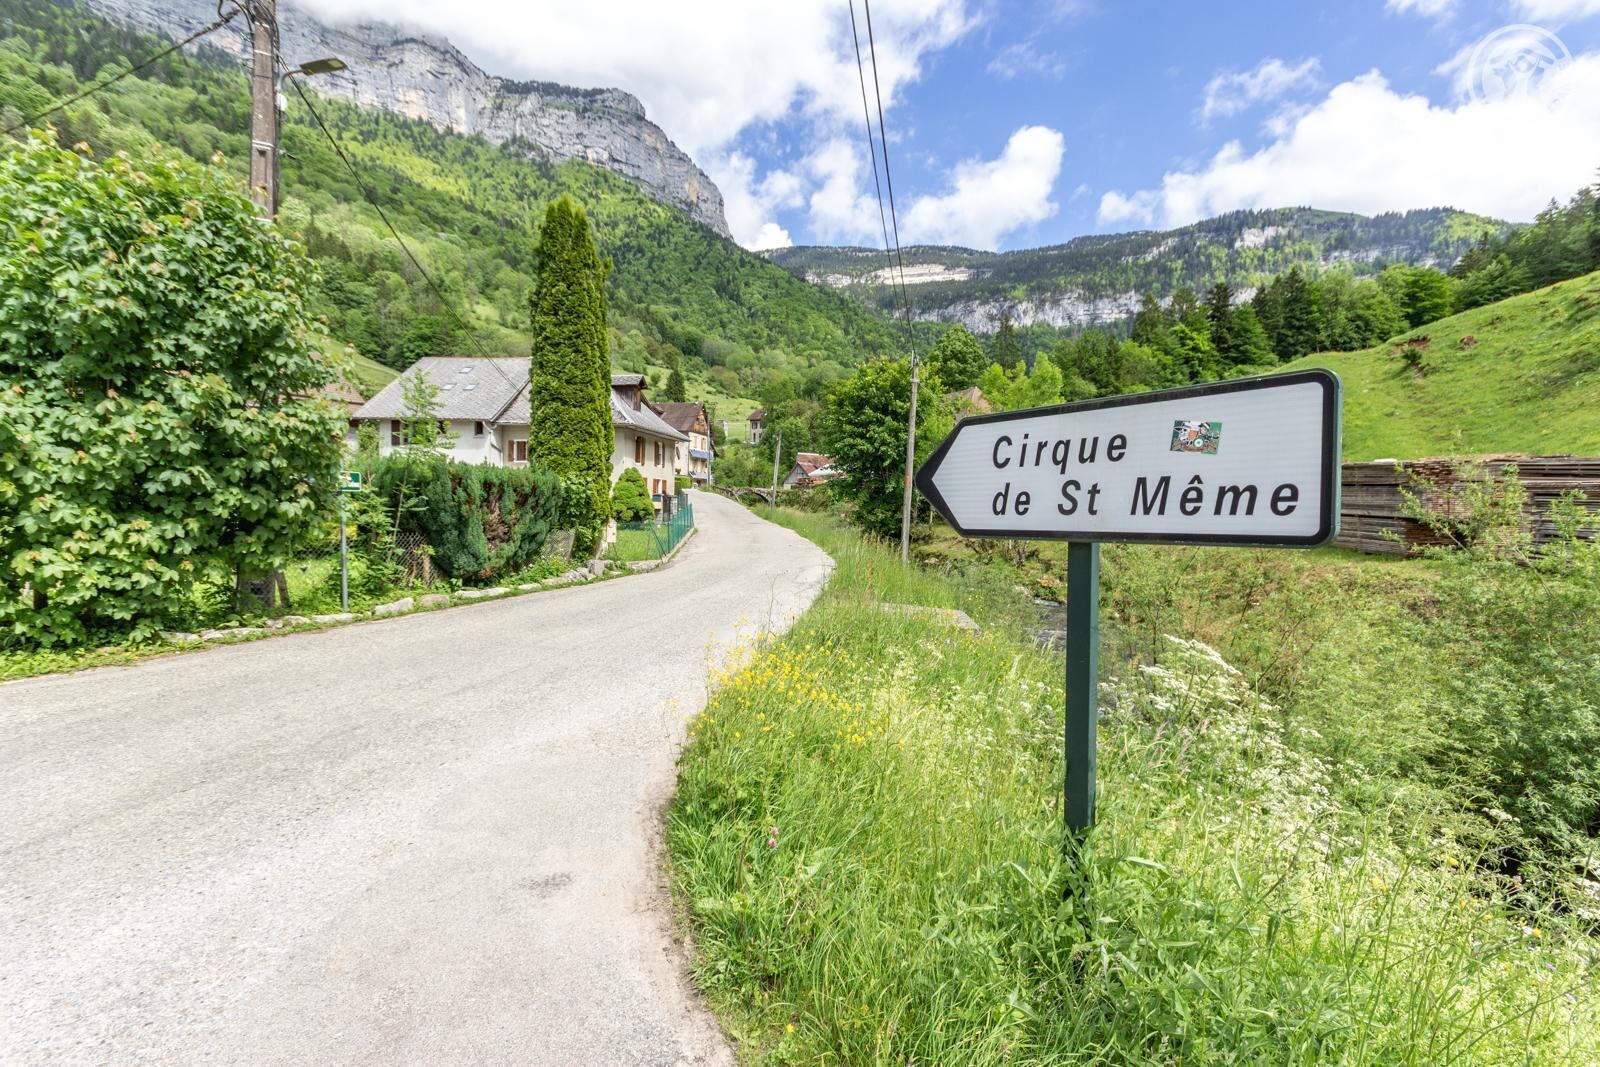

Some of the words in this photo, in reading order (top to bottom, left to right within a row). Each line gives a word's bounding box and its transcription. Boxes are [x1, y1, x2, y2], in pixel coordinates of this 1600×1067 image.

[992, 433, 1128, 475] Cirque
[991, 482, 1031, 517] de
[1057, 479, 1101, 516] St
[1129, 474, 1300, 517] Même
